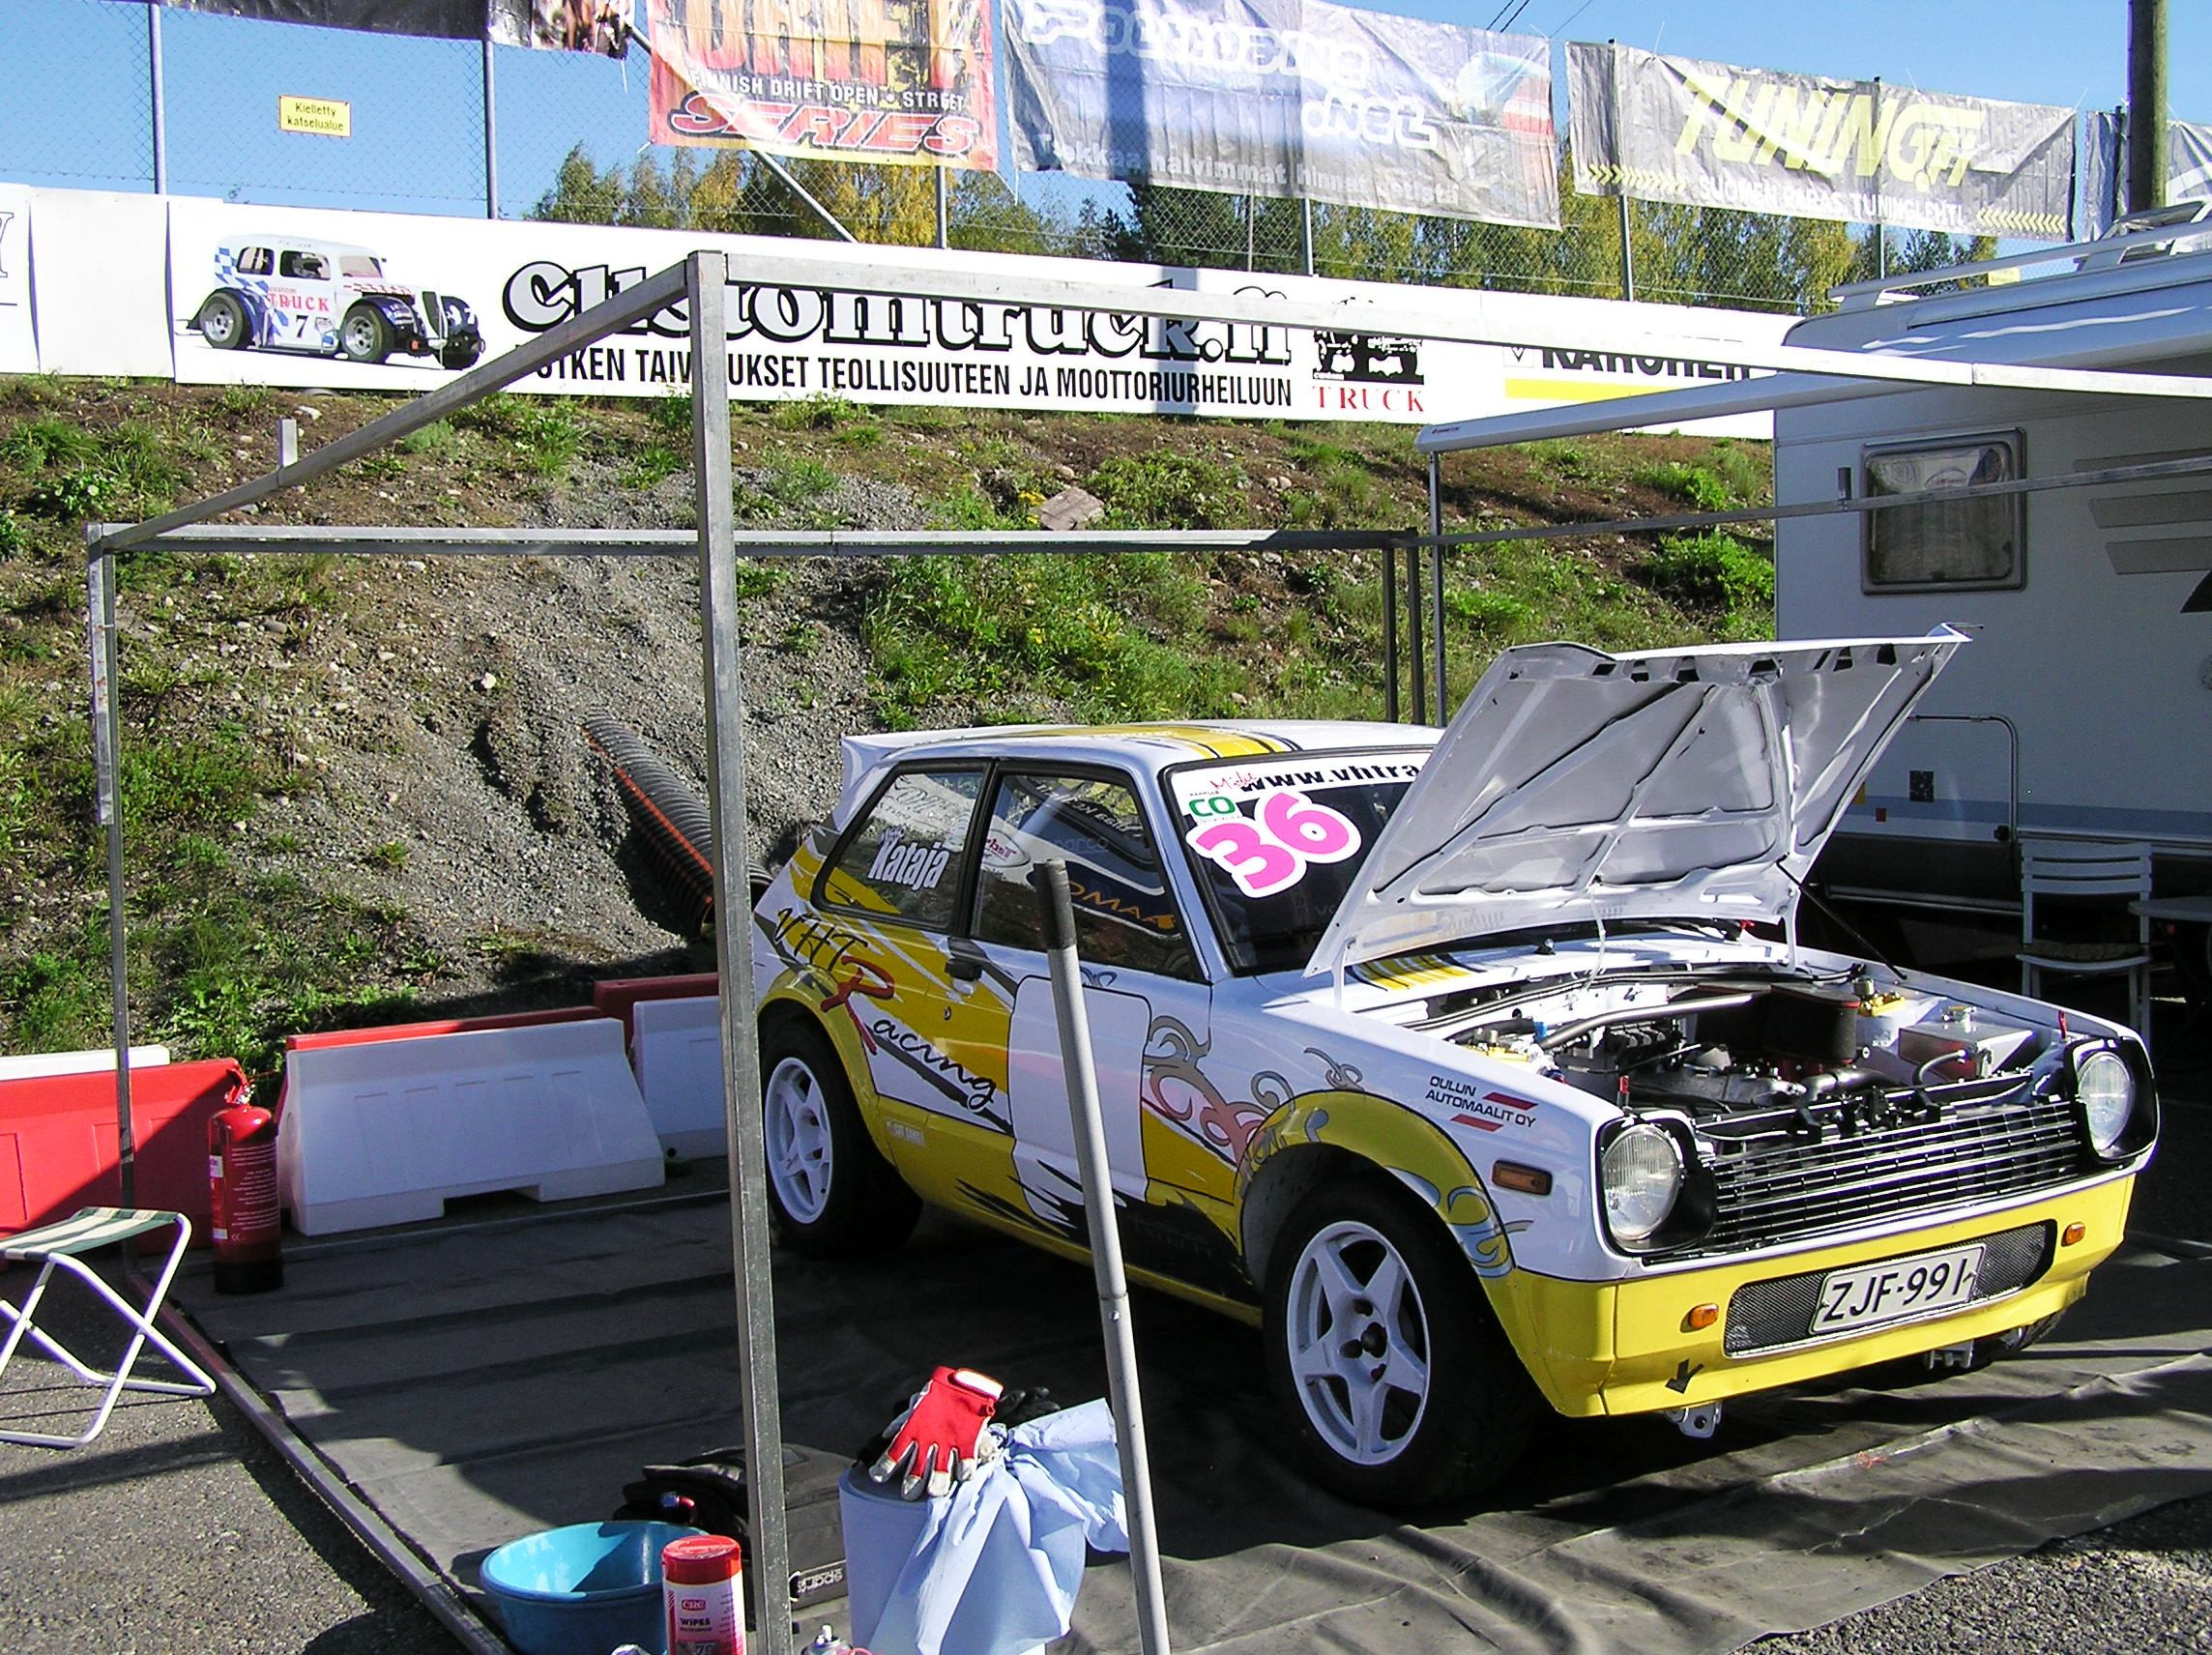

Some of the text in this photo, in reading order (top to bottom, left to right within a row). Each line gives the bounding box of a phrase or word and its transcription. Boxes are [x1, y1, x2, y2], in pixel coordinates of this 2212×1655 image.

[295, 102, 336, 117] Kielletty
[689, 73, 965, 111] FINNISH DRIFT OPEN STREET
[669, 91, 982, 156] SERIES
[1150, 149, 1286, 185] halvimmat
[269, 294, 329, 311] TRUCK
[296, 315, 308, 337] 7
[817, 357, 1010, 395] TEOLLISUUTEEN
[1020, 366, 1050, 396] JA
[1057, 367, 1293, 407] MOOTTORIURHEILUUN
[1312, 386, 1424, 412] TRUCK
[1188, 796, 1236, 817] CO
[1194, 791, 1352, 892] 36
[867, 838, 950, 891] Kataja
[773, 907, 868, 973] VHT
[820, 954, 997, 1110] Racing
[1430, 1076, 1476, 1096] OULUN
[1426, 1089, 1536, 1127] AUTOMAALIT OY
[1822, 1257, 1968, 1322] ZJF-991
[680, 1617, 711, 1626] WIPES
